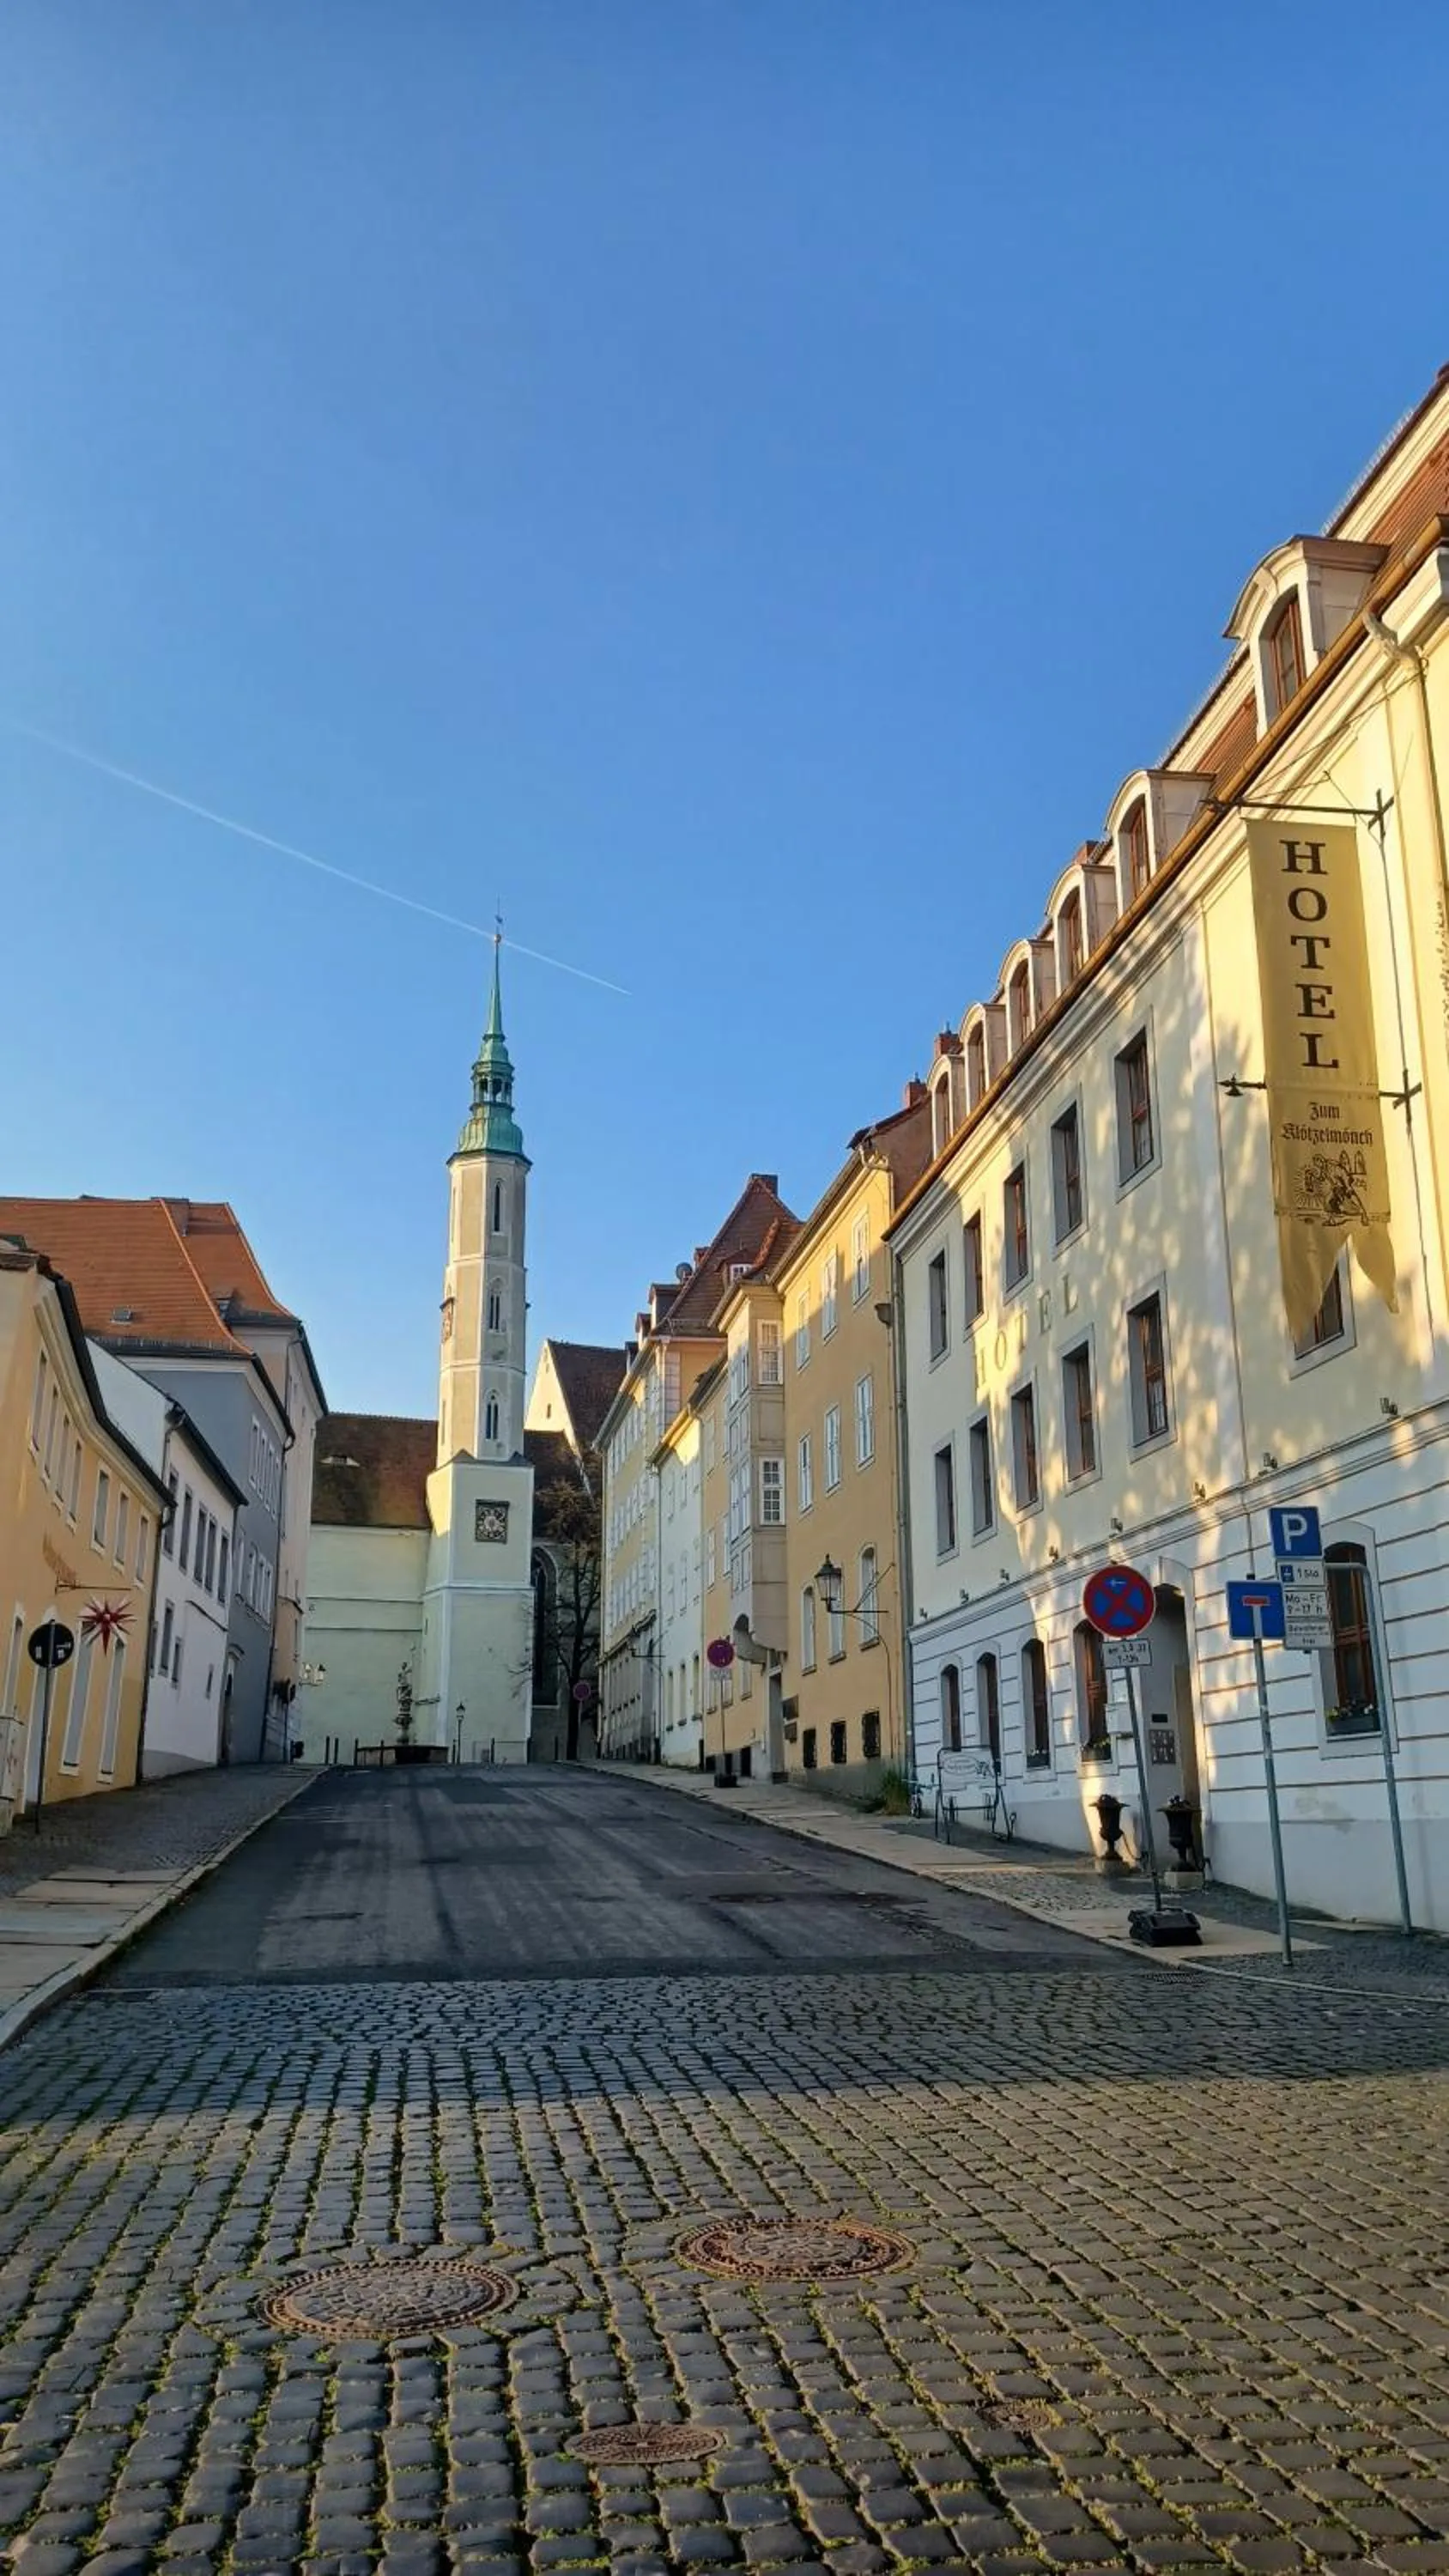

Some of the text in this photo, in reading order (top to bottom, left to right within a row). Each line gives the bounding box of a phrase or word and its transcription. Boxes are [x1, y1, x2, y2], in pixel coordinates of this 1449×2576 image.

[1279, 839, 1339, 1069] HOTEL
[1307, 1102, 1341, 1121] Zum
[1278, 1122, 1373, 1147] Klötzelmönch
[1281, 1514, 1307, 1551] P
